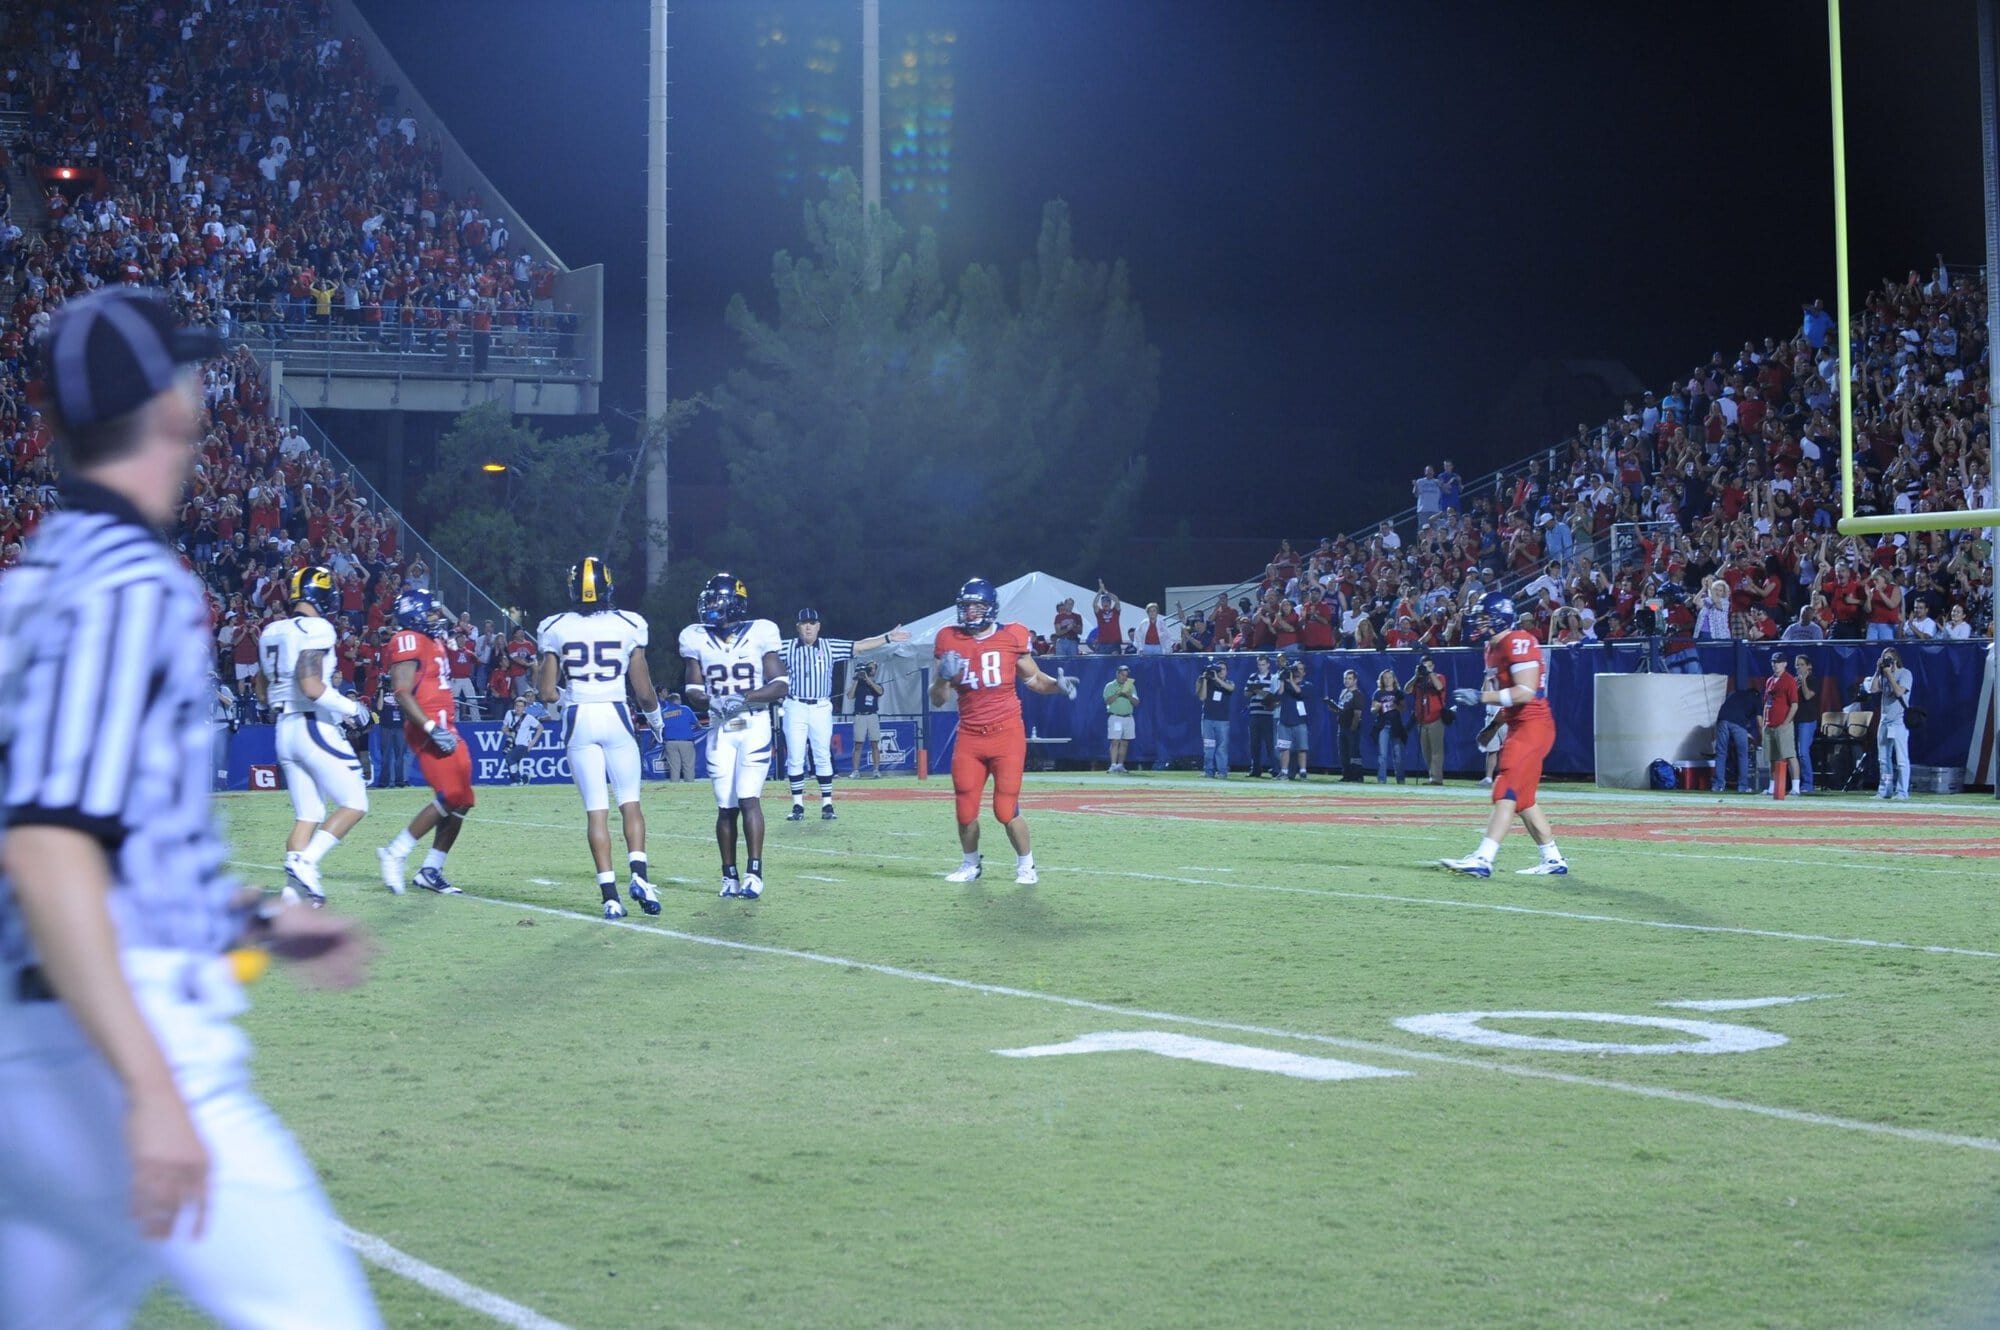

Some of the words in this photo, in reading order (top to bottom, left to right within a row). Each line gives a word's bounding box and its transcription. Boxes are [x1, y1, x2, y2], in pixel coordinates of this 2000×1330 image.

[1618, 535, 1633, 549] 26
[397, 634, 417, 654] 10
[1511, 638, 1531, 655] 37
[266, 644, 280, 684] 7
[561, 641, 623, 682] 25
[959, 651, 1002, 690] 48
[706, 662, 756, 698] 29
[254, 769, 277, 788] G
